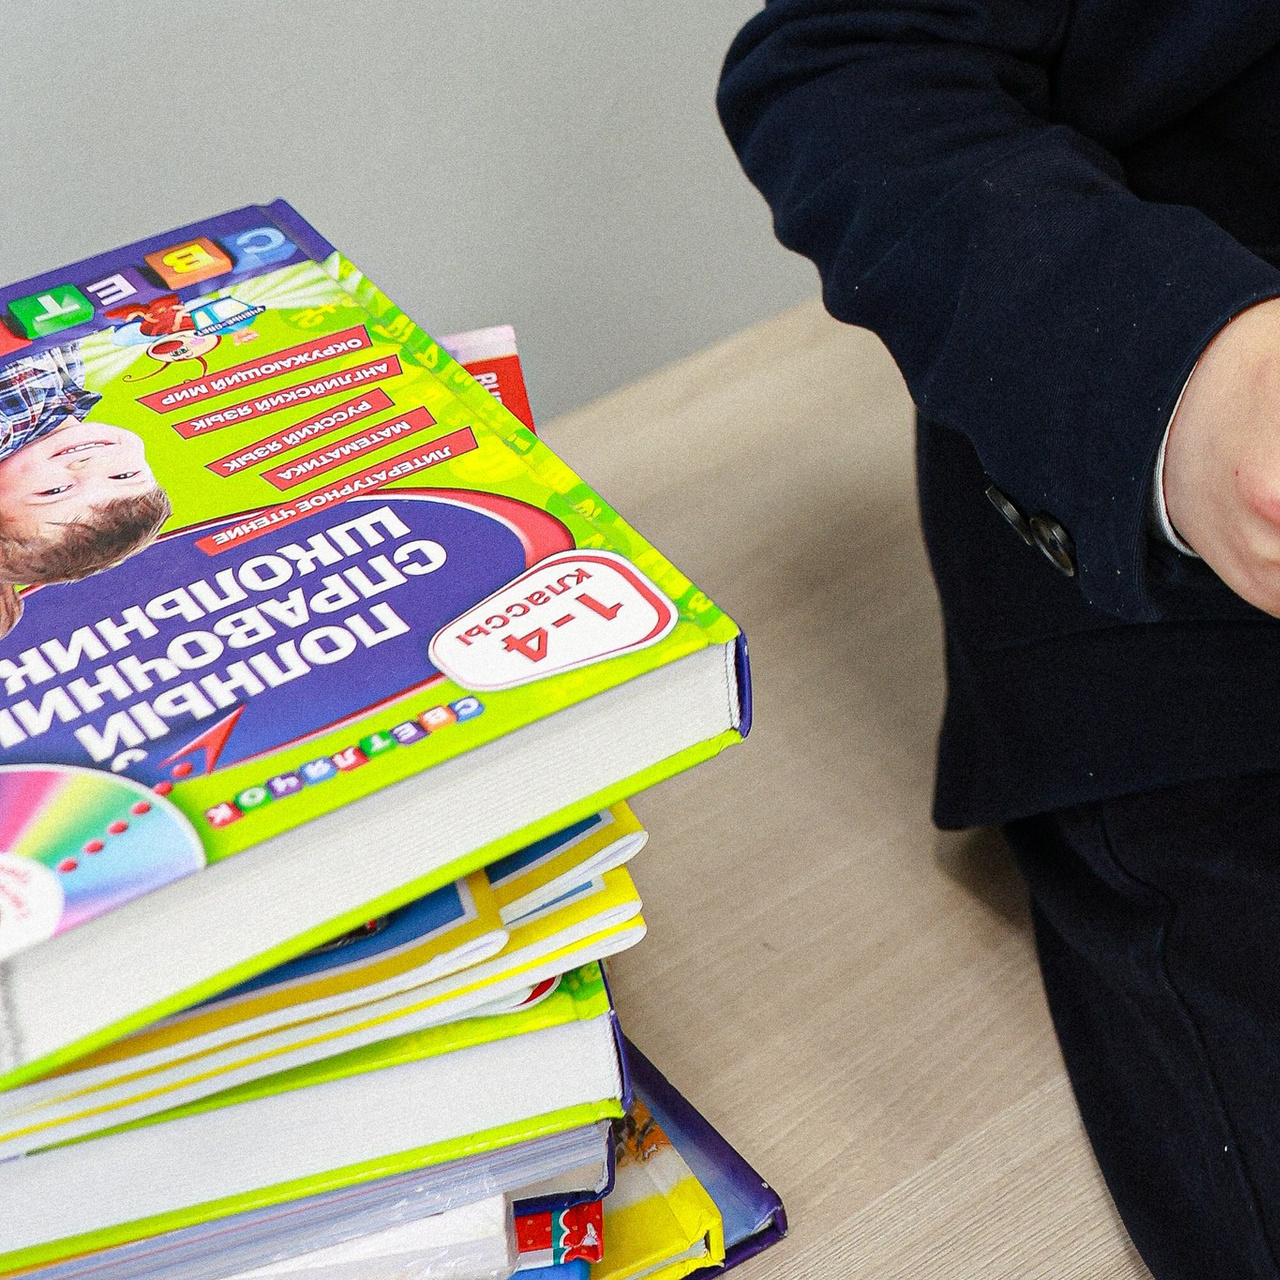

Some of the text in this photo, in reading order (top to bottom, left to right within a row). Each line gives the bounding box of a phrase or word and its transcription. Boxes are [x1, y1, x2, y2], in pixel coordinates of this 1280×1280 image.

[161, 337, 363, 406] ОКРУЖАЮЩИЙ МИР
[190, 362, 389, 432] АНГЛИЙСКИЙ ЯЗЫК
[222, 399, 372, 472] РУССКИЙ ЯЗЫК
[276, 420, 411, 481] МАТЕМАТИКА
[211, 446, 452, 547] ЛИТЕРАТУРНОЕ ЧТЕНИЕ
[500, 592, 626, 663] 1-4
[74, 601, 411, 773] ПОЛНЫЙ
